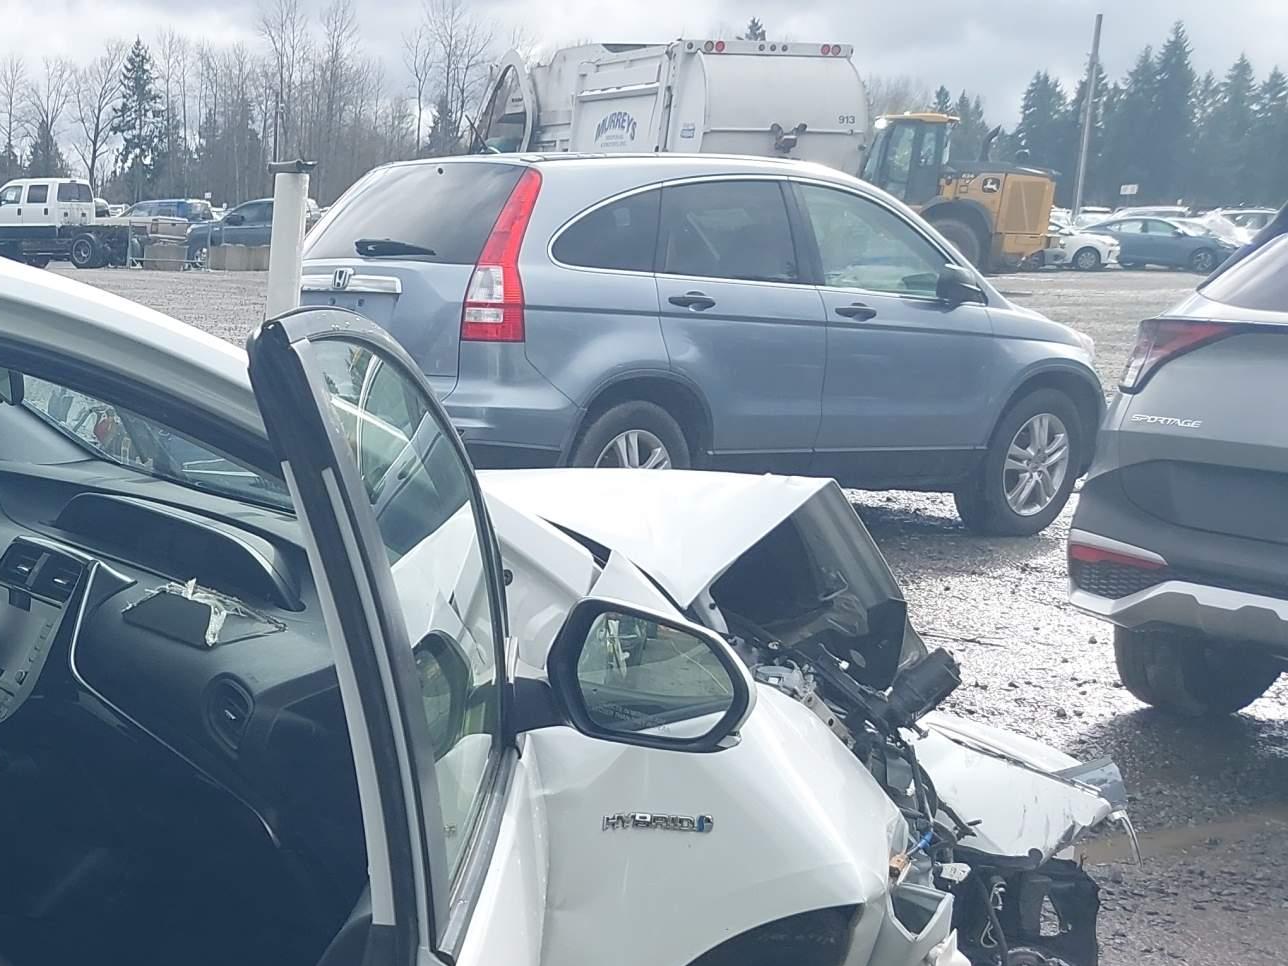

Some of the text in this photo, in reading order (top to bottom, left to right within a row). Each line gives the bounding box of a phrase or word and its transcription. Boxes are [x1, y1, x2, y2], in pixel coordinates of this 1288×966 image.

[838, 115, 856, 125] 913
[1131, 414, 1202, 428] SPORTAGE
[602, 812, 697, 832] HYBRID
